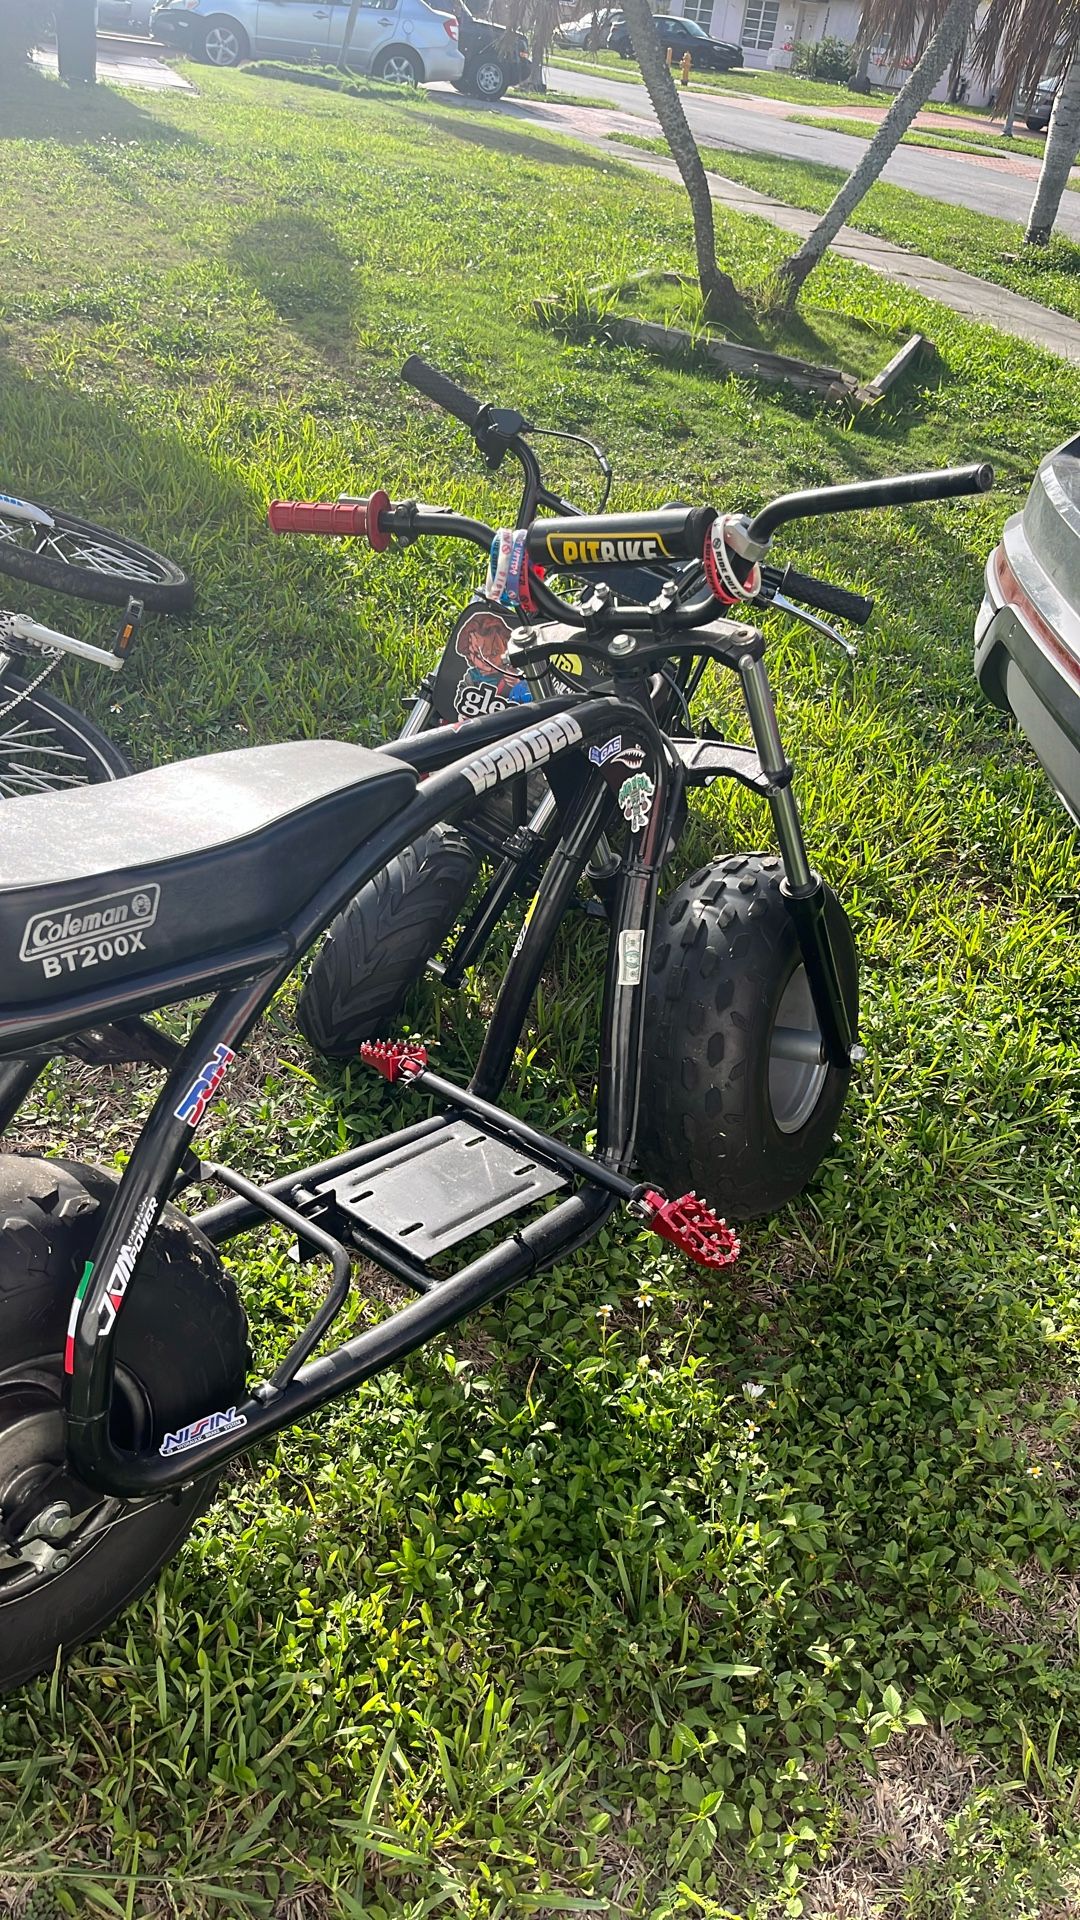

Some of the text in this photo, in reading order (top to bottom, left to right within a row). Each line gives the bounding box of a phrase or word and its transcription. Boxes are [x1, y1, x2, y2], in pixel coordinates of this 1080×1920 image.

[563, 540, 658, 565] PITBIKE
[601, 740, 621, 761] GAS
[32, 904, 129, 947] Coleman
[42, 932, 146, 979] BT200X
[98, 1197, 159, 1336] JDM POWER
